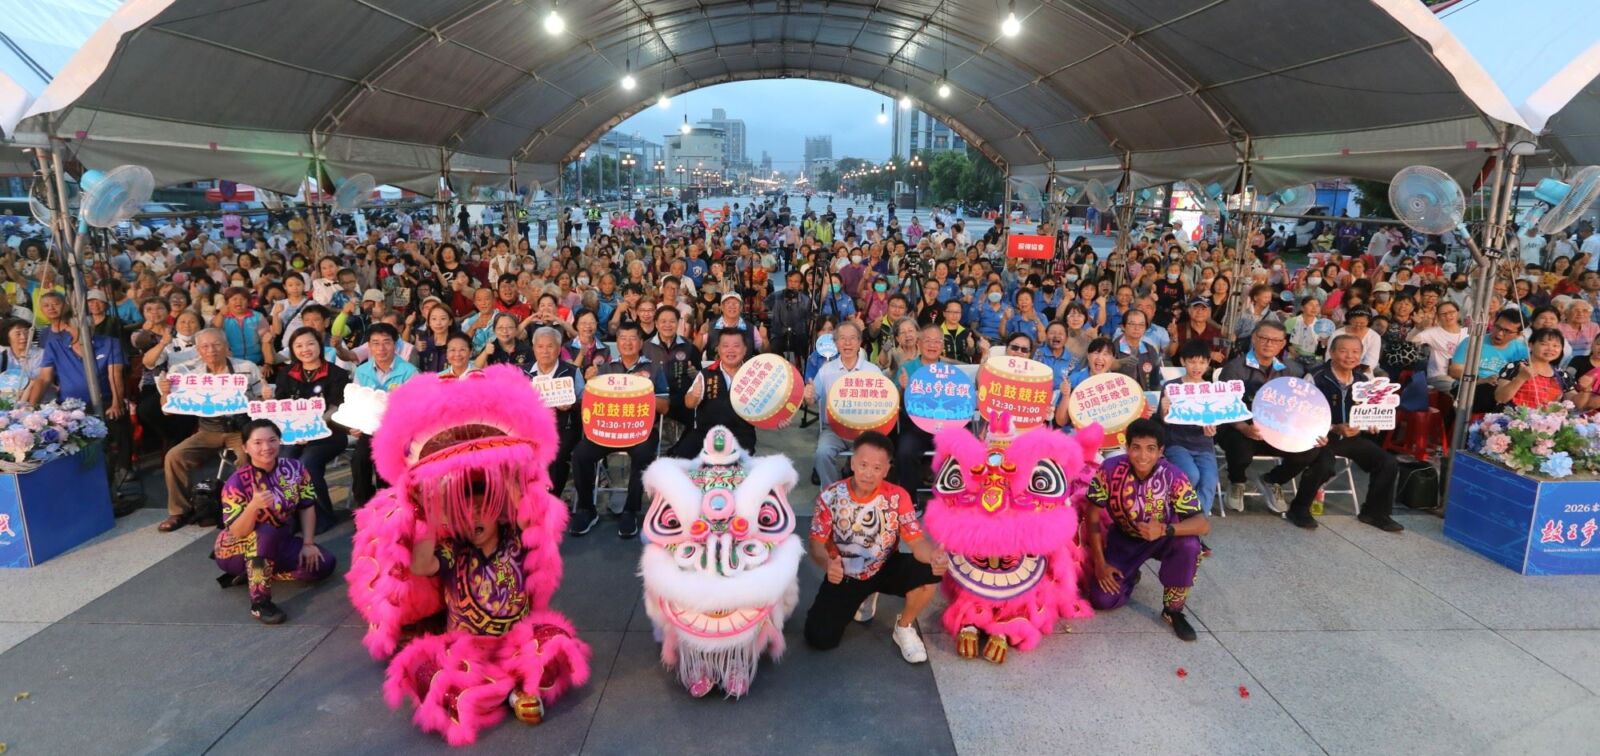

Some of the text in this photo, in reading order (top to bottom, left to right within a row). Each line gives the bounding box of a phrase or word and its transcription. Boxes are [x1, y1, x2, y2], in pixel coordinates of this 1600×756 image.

[844, 378, 885, 388] 鼓動客庄
[1075, 376, 1127, 402] 鼓王爭霸戰
[1169, 382, 1243, 396] 鼓聲震山海
[989, 381, 1048, 404] 尬鼓競技
[592, 402, 650, 417] 尬鼓競技
[991, 398, 1040, 413] 12:30-17:00
[596, 419, 645, 429] 12:30-17:00
